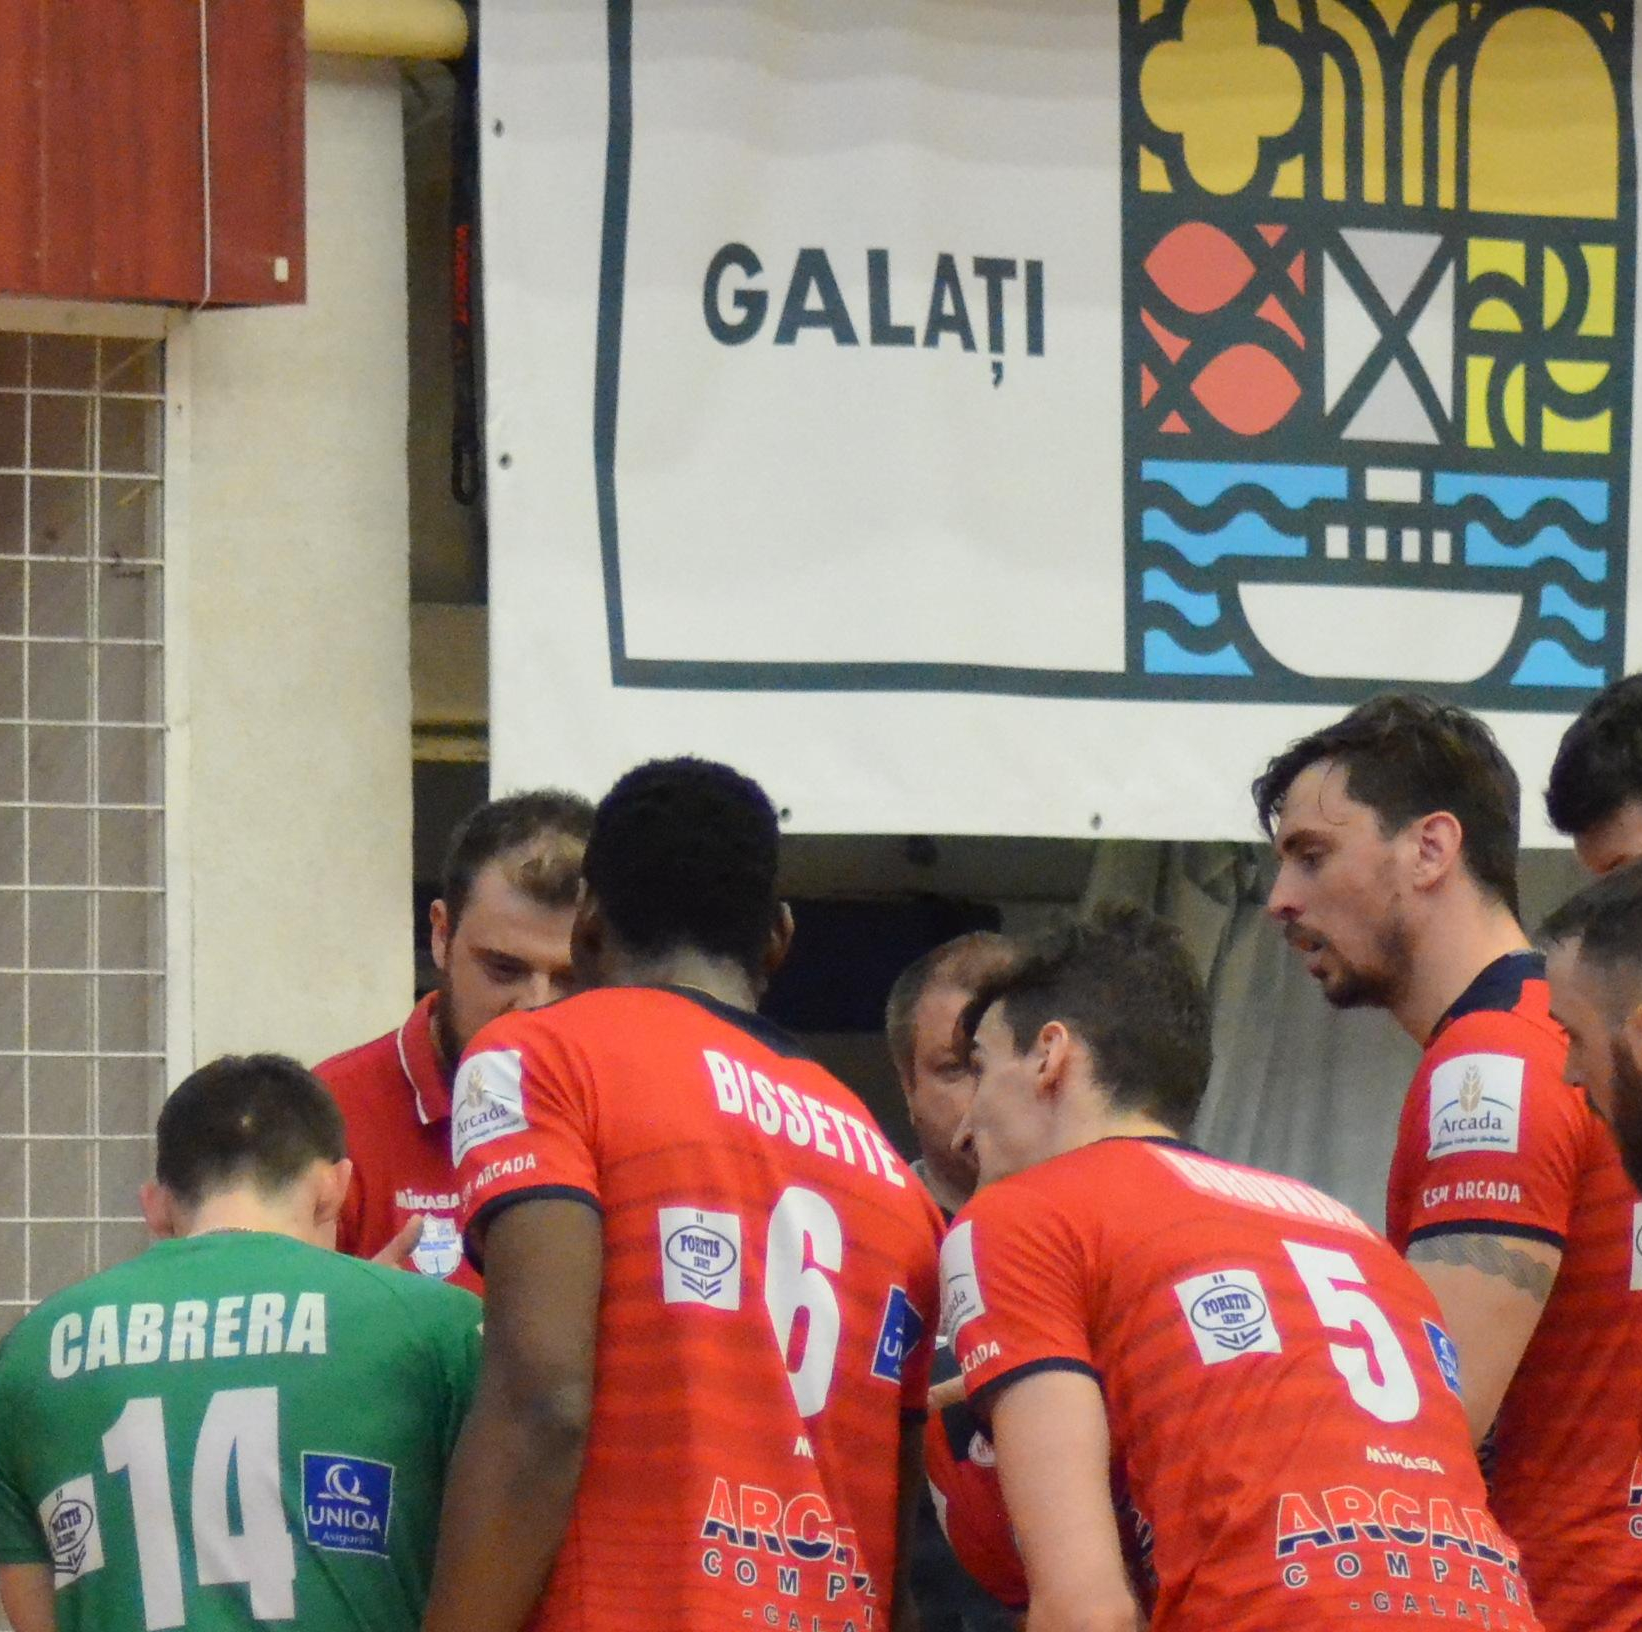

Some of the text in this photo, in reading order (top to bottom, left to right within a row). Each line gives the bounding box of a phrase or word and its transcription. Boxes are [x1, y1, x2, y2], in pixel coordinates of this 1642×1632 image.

[702, 242, 1046, 387] GALAȚI
[703, 1049, 906, 1188] BISSETTE
[1438, 1111, 1503, 1136] Arcada
[1455, 1179, 1522, 1204] ARCADA
[48, 1291, 328, 1381] CABRERA
[765, 1186, 845, 1418] 6
[1281, 1238, 1421, 1424] 5
[100, 1385, 297, 1632] 14
[308, 1504, 382, 1535] UNIQA
